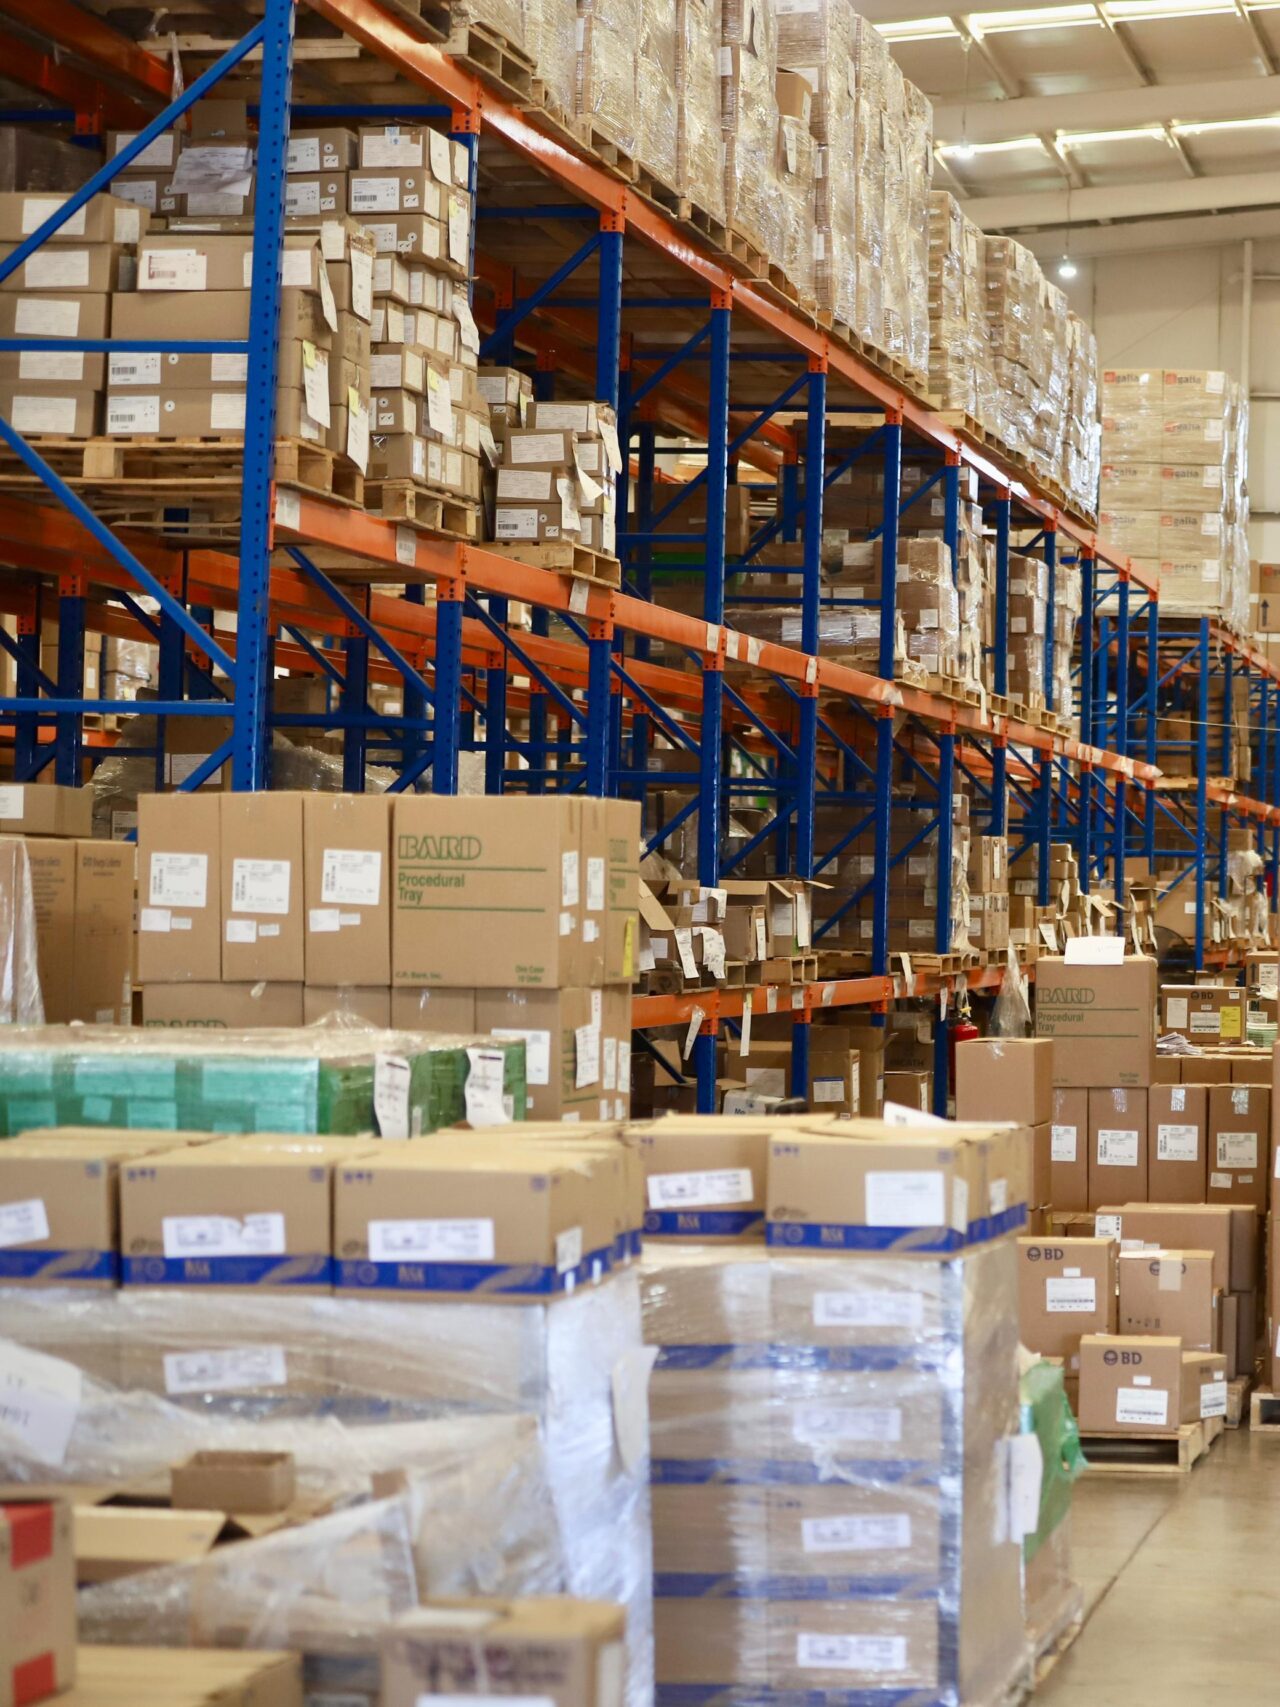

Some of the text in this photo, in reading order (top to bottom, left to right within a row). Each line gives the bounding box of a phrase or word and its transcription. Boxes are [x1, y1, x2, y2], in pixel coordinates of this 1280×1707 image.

[1116, 373, 1140, 385] galia
[1177, 376, 1202, 385] galia
[1174, 468, 1199, 479] galia
[1173, 516, 1197, 527] galia
[398, 835, 482, 861] BARD
[398, 873, 465, 888] Procedural
[398, 887, 423, 905] Tray
[1037, 987, 1095, 1004] BARD
[1201, 991, 1214, 999] BD
[1038, 1012, 1084, 1022] Procedural
[1038, 1022, 1055, 1032] Tray
[1044, 1249, 1064, 1260] BD
[1122, 1352, 1142, 1365] BD
